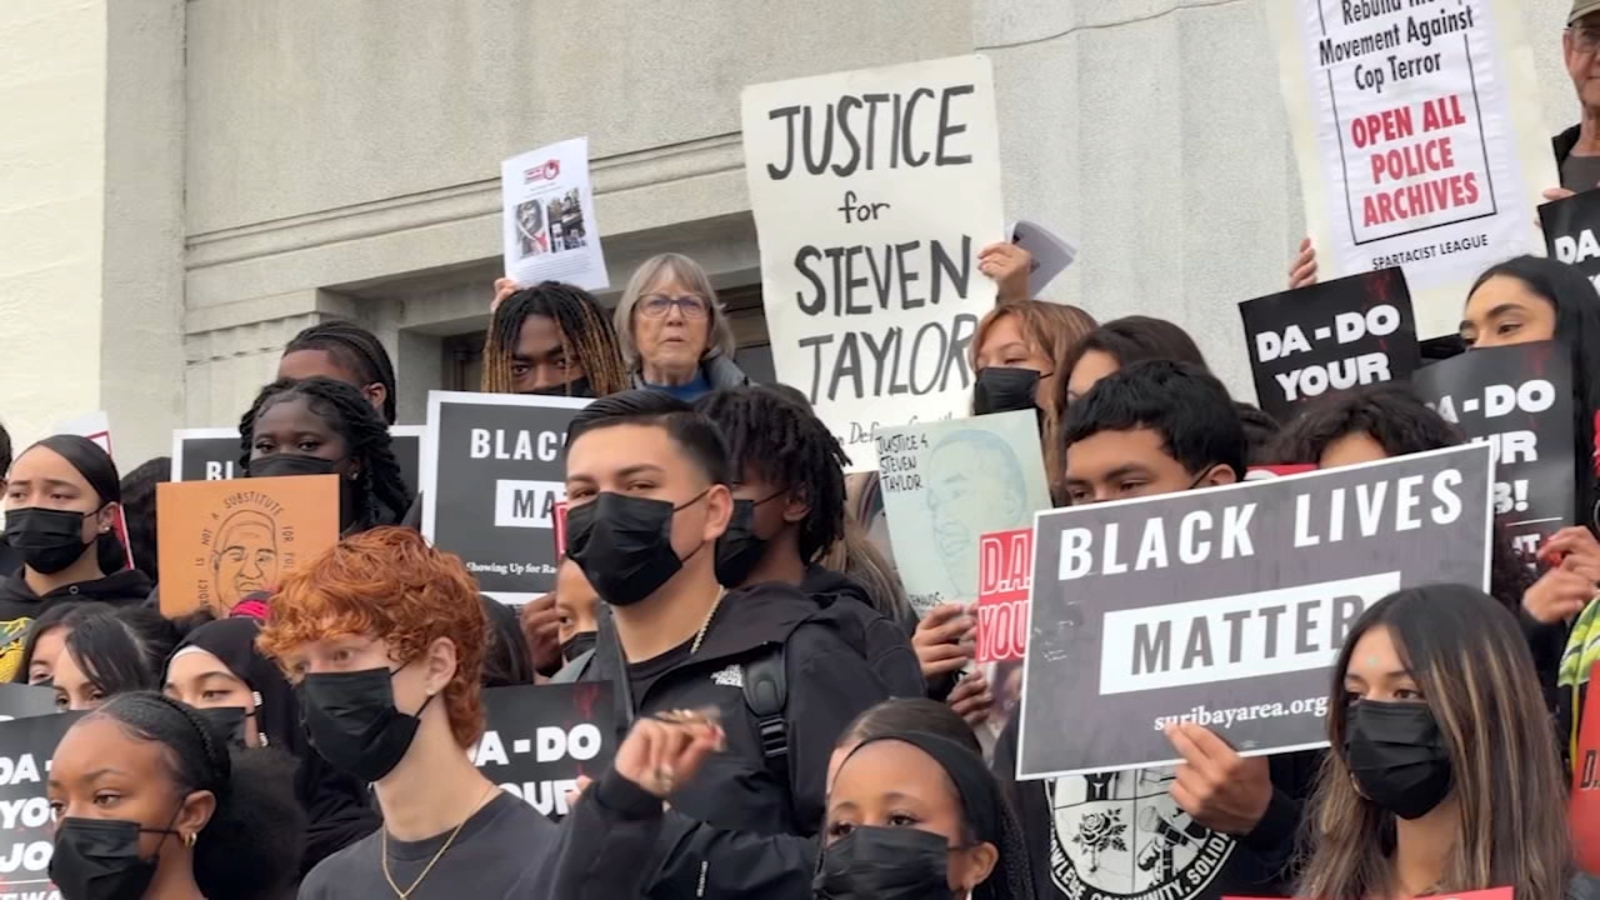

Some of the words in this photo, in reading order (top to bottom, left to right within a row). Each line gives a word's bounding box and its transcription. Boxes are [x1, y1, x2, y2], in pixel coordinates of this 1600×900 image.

[1319, 24, 1400, 66] Movement
[1407, 5, 1474, 47] Against
[1355, 64, 1384, 93] Cop
[1388, 53, 1442, 82] Terror
[767, 84, 975, 180] JUSTICE
[1352, 106, 1414, 149] OPEN
[1423, 94, 1466, 132] ALL
[1370, 137, 1454, 184] POLICE
[838, 190, 891, 224] for
[1363, 172, 1479, 227] ARCHIVES
[794, 234, 972, 317] STEVEN
[1372, 245, 1436, 270] SPARTACIST
[1440, 234, 1489, 255] LEAGUE
[798, 313, 979, 406] TAYLOR
[1275, 352, 1391, 401] YOUR
[470, 428, 568, 461] BLAC
[875, 434, 918, 456] JUSTICE
[880, 455, 917, 475] STEVEN
[512, 489, 566, 518] MA
[881, 474, 924, 493] TAYLOR
[201, 529, 213, 546] NOT
[224, 490, 285, 518] SUBSTITUTE
[1058, 502, 1257, 581] BLACK
[1294, 468, 1464, 548] LIVES
[466, 562, 508, 576] Showing
[510, 563, 524, 576] Up
[525, 563, 540, 573] for
